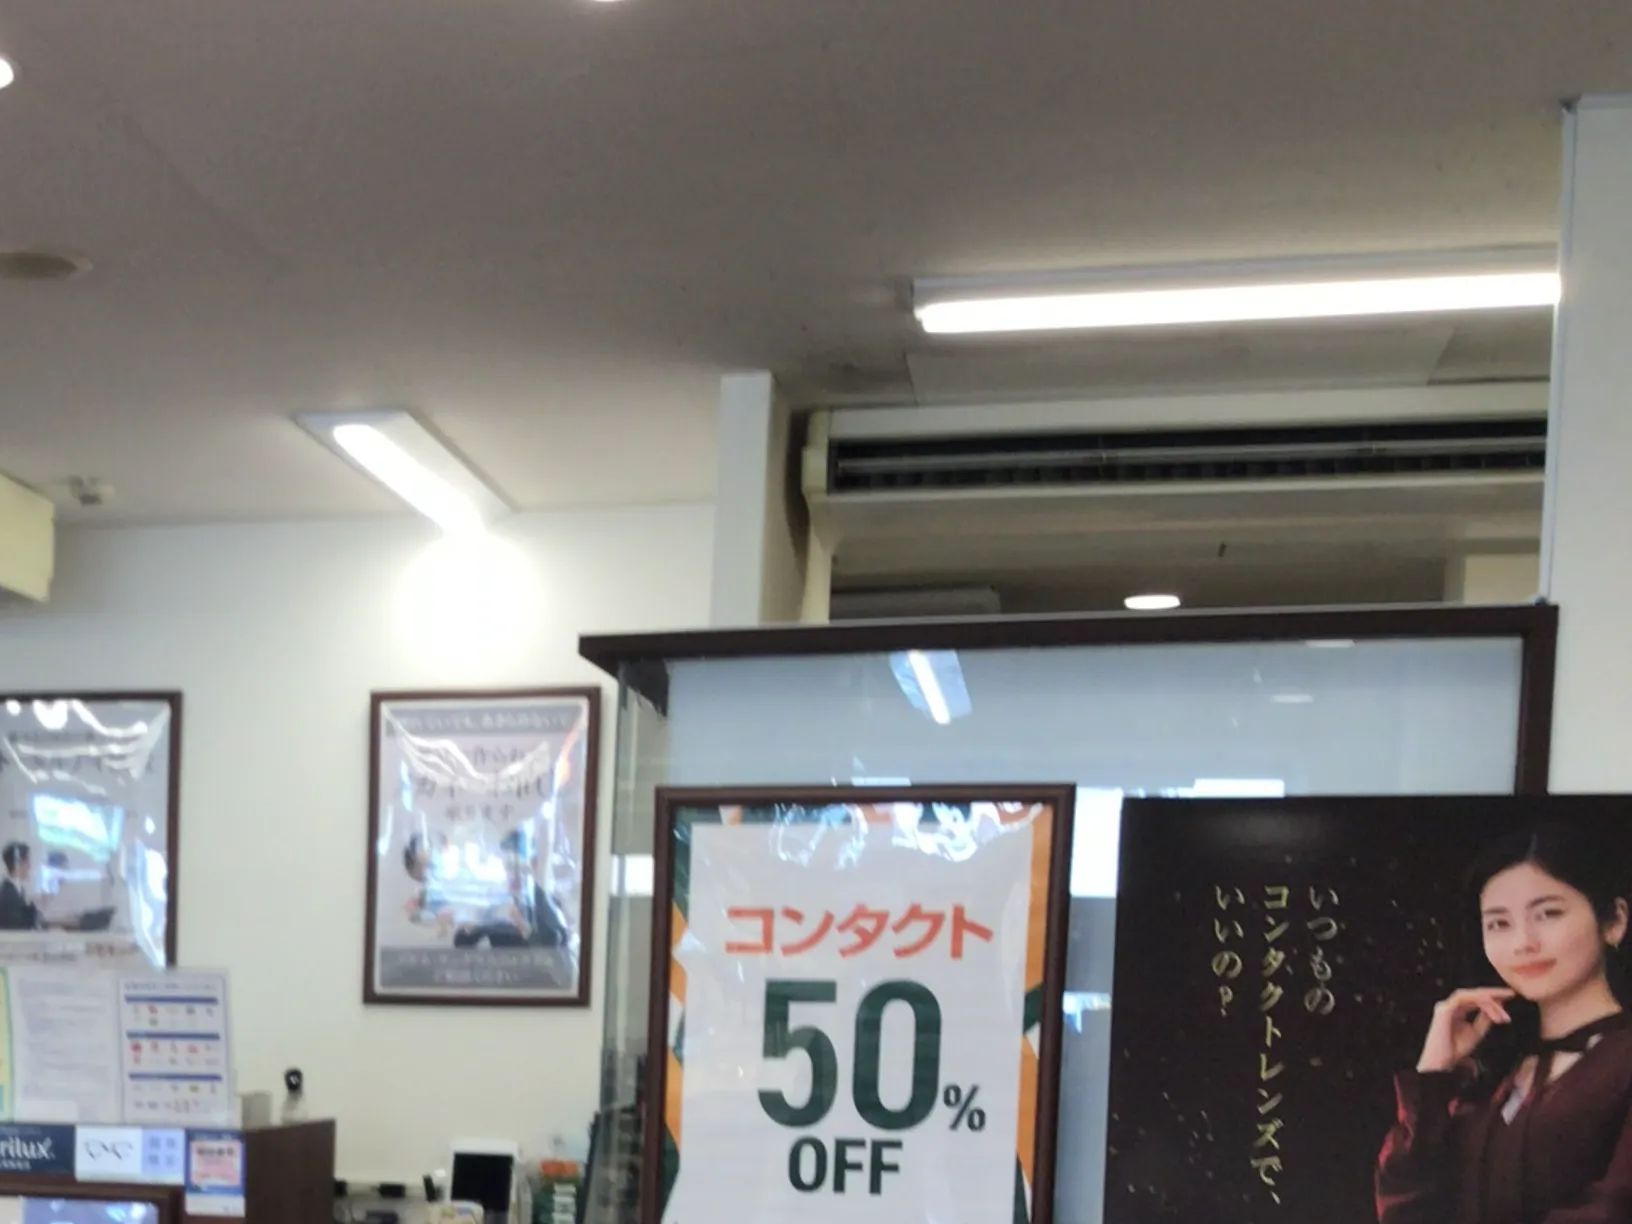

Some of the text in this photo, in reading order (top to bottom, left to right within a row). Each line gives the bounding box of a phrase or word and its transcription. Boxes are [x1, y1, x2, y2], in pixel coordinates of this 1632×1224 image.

[724, 903, 994, 960] コンタクト
[1304, 885, 1339, 1015] いつもの
[1251, 885, 1289, 1204] コンタクトレンズで、
[787, 1136, 904, 1195] OFF
